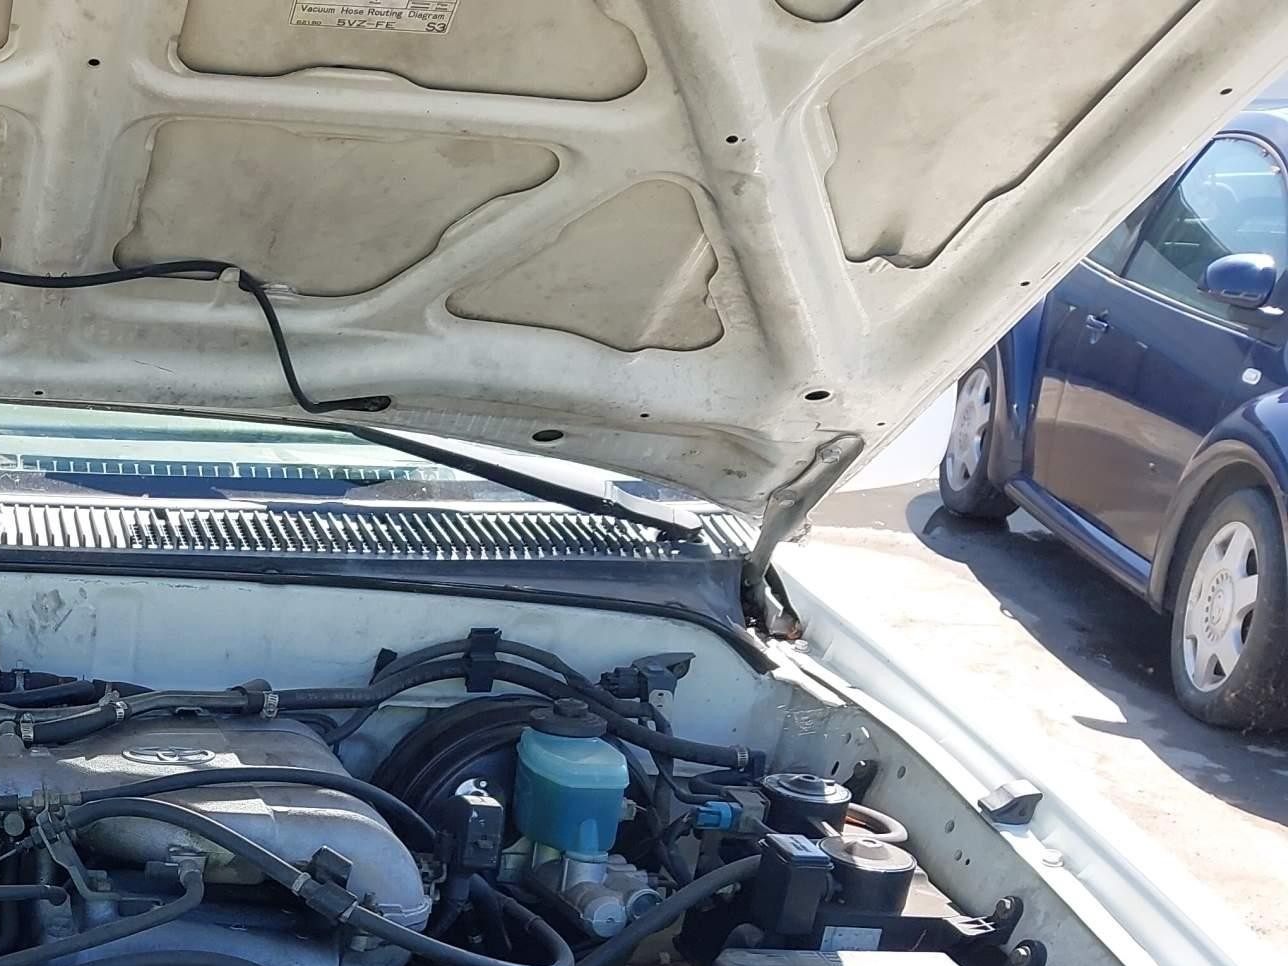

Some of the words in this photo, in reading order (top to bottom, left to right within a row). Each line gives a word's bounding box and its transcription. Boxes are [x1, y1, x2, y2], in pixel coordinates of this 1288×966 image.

[300, 4, 336, 14] Vacuum
[340, 7, 365, 16] Hose
[367, 8, 404, 19] Routing
[407, 11, 446, 21] Diagram
[336, 18, 397, 29] 5VZ-FE
[425, 22, 448, 33] S3
